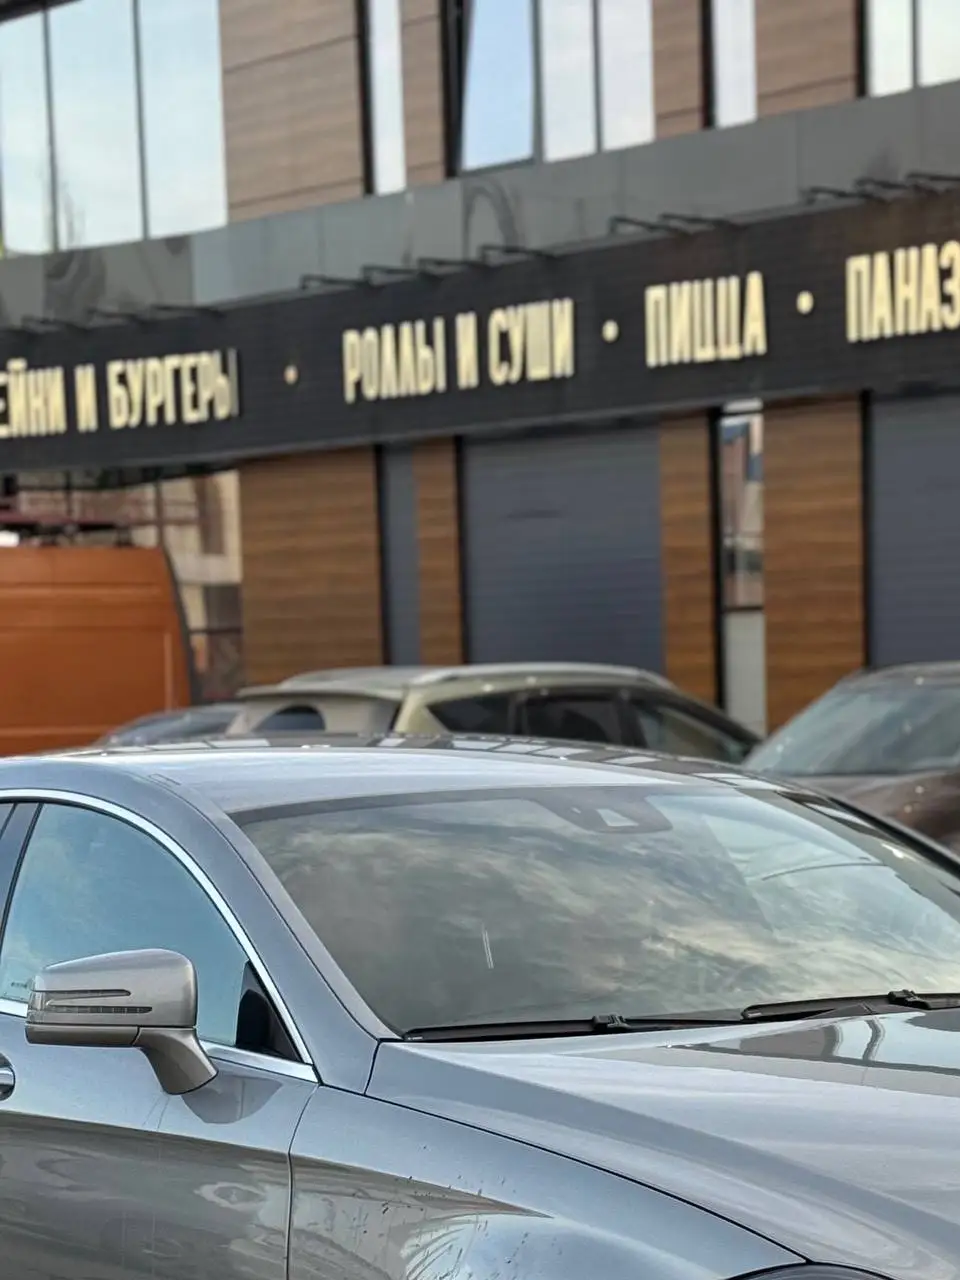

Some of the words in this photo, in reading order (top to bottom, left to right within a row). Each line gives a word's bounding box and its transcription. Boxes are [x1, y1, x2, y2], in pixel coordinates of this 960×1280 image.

[74, 364, 98, 433] И
[106, 348, 239, 430] БУРГЕРЫ
[342, 317, 447, 403] РОЛЛЫ
[455, 311, 479, 389] И
[487, 297, 574, 386] СУШИ
[644, 270, 767, 368] ПИЦЦА
